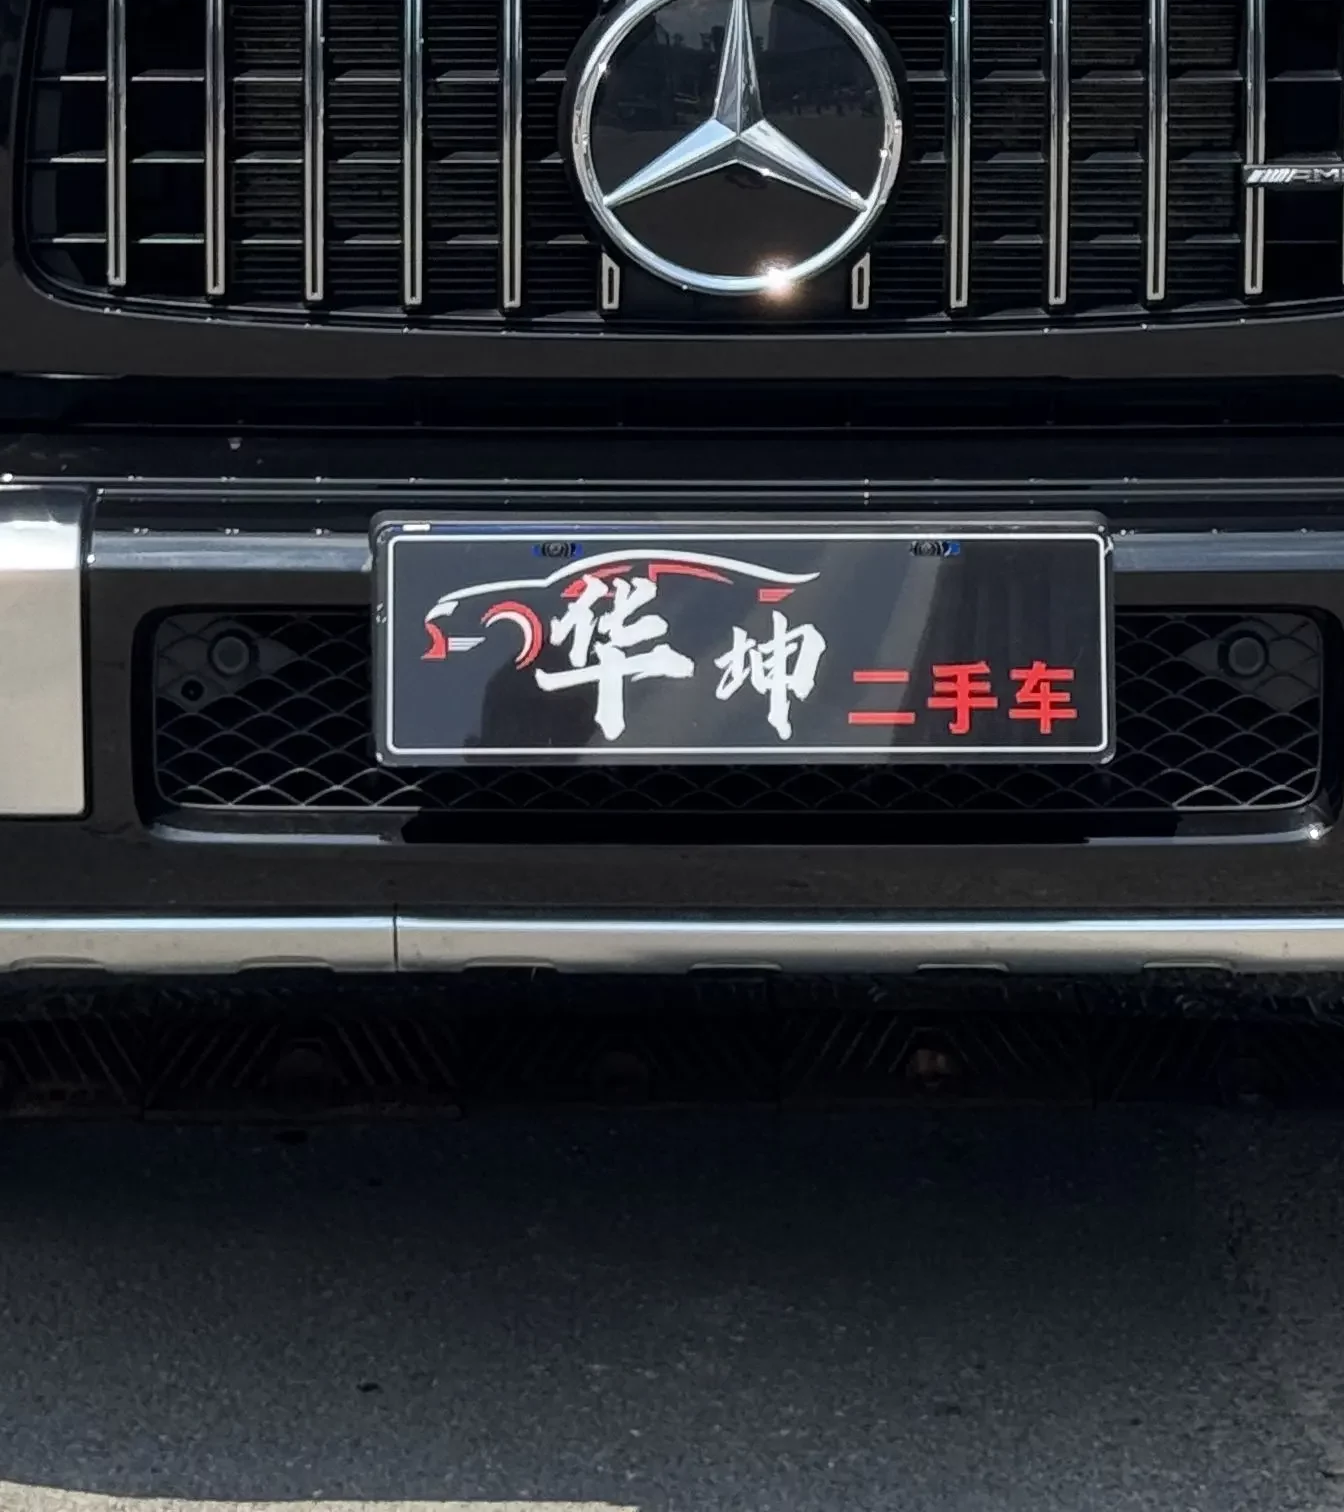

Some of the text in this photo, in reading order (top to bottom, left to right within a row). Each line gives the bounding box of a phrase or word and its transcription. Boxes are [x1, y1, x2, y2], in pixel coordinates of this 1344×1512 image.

[535, 574, 826, 741] 华坤
[848, 660, 1078, 735] 二手车
